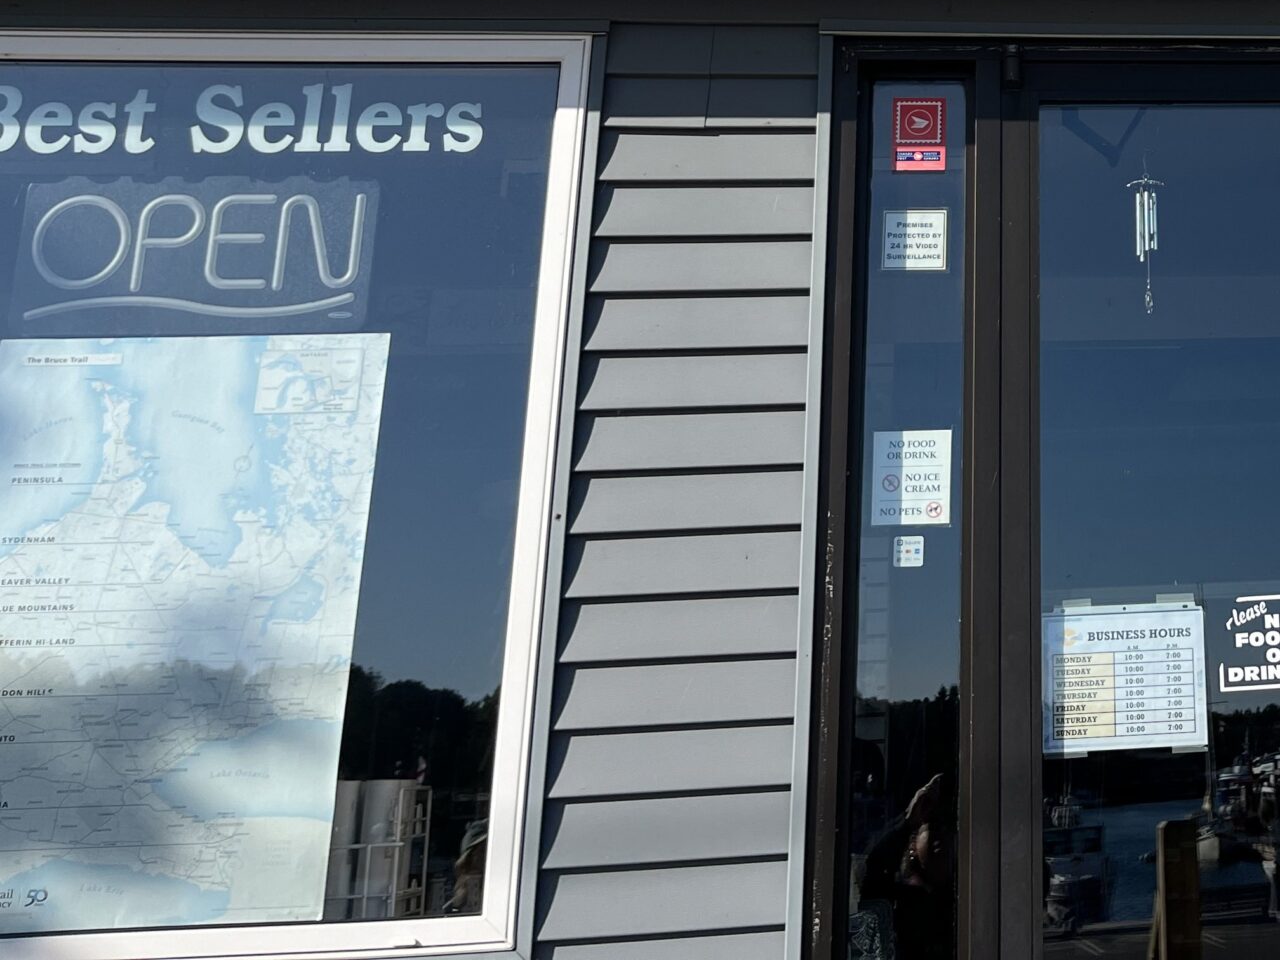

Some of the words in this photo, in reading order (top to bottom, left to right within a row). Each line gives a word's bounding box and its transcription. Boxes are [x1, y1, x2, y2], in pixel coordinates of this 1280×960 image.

[190, 83, 484, 155] Sellers
[32, 193, 368, 292] OPEN
[27, 356, 42, 364] The
[44, 356, 68, 364] Bruce
[71, 356, 89, 364] Trail
[889, 440, 905, 448] NO
[907, 440, 936, 448] FOOD
[887, 452, 902, 460] OR
[904, 451, 937, 459] DRINK
[905, 473, 921, 482] NO
[924, 473, 940, 481] ICE
[904, 485, 941, 493] CREAM
[880, 508, 896, 516] NO
[898, 507, 922, 516] PETS
[1, 536, 55, 544] SYDENHAM
[35, 577, 70, 585] VALLEY
[18, 603, 76, 611] MOUNTAINS
[1087, 629, 1146, 642] BUSINESS
[1149, 627, 1191, 639] HOURS
[1056, 656, 1092, 664] MONDAY
[1056, 668, 1091, 676] TUESDAY
[1056, 680, 1105, 688] WEDNESDAY
[1056, 692, 1098, 700] THURSDAY
[1056, 716, 1098, 724] SATURDAY
[1056, 729, 1088, 737] SUNDAY
[24, 888, 48, 907] 50
